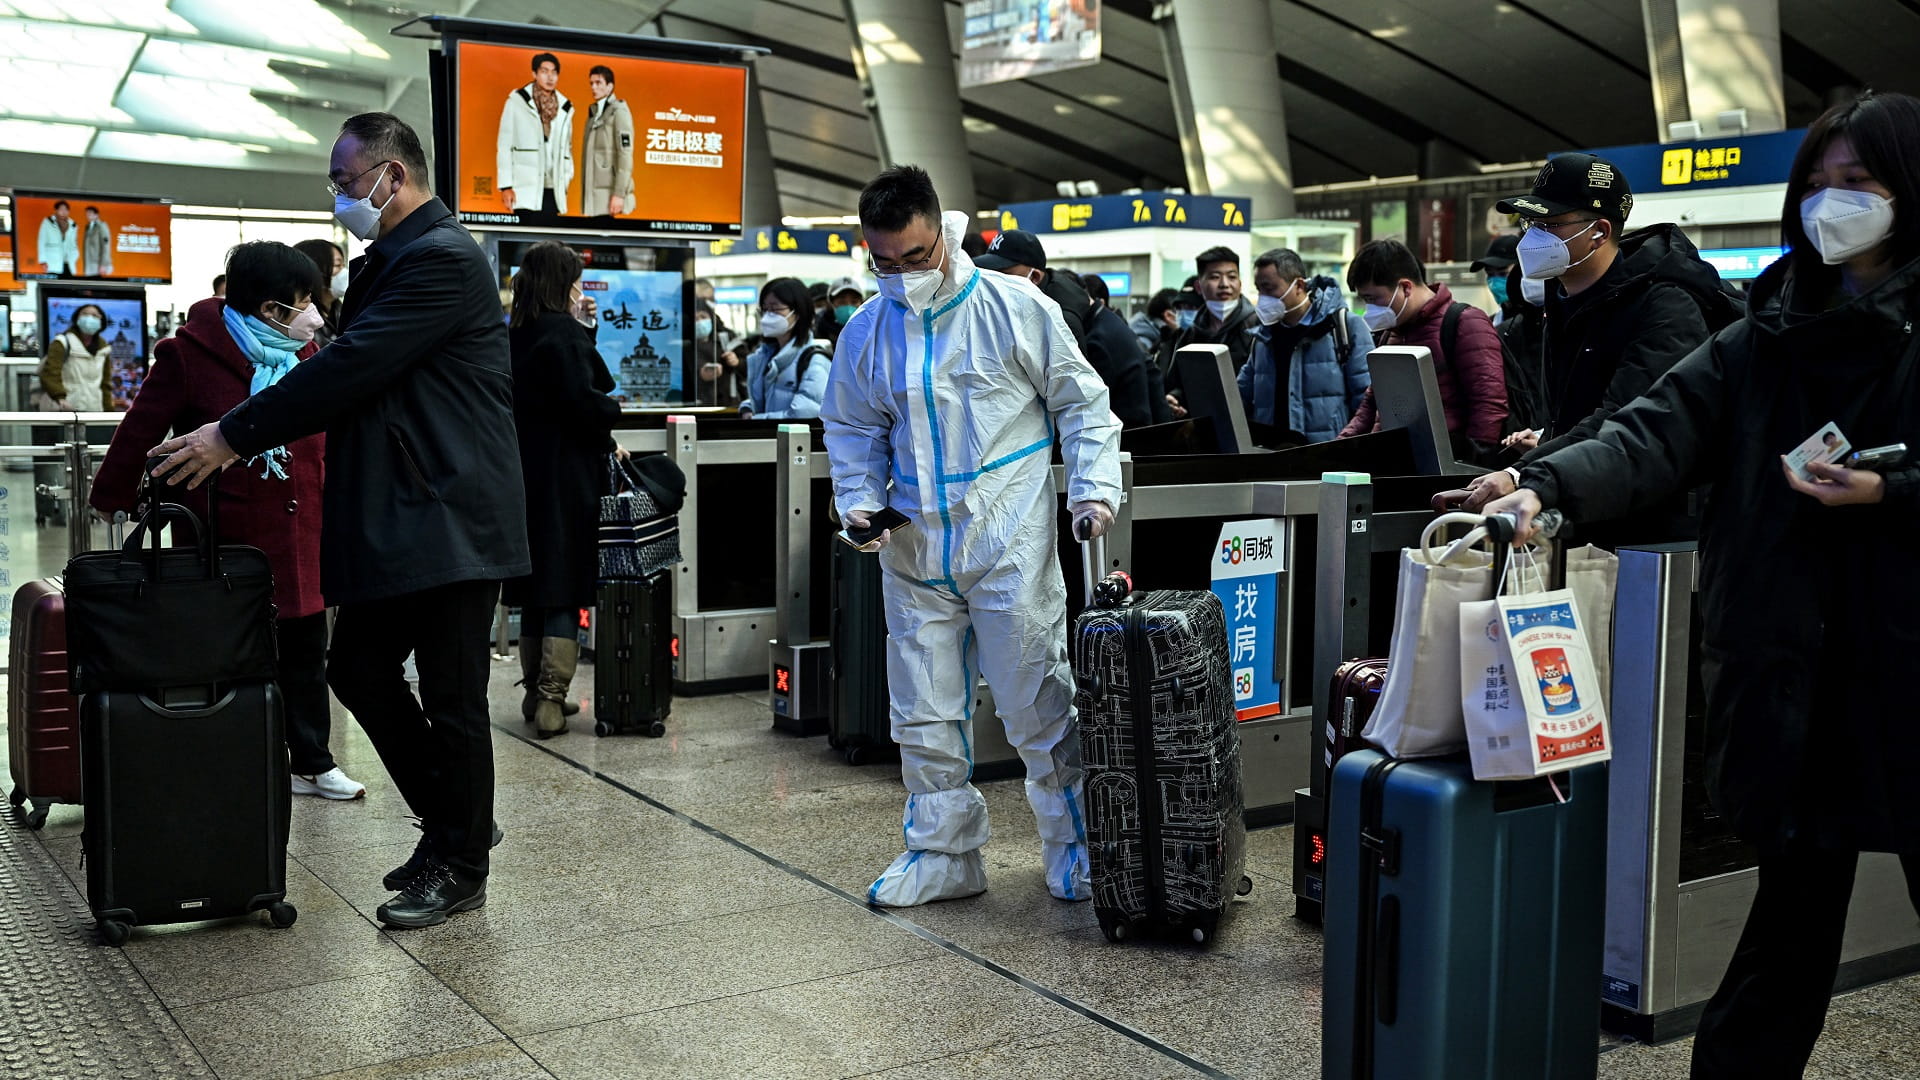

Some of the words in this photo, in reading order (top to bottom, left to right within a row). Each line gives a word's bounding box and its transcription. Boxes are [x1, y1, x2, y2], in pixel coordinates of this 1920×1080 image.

[646, 128, 722, 153] 无惧极寒
[1695, 147, 1741, 169] 检票口
[1132, 199, 1151, 222] 7A
[1164, 199, 1187, 223] 7A
[1222, 203, 1245, 226] 7A
[602, 301, 671, 331] 味道
[1221, 535, 1273, 565] 58同城
[1233, 583, 1259, 663] 找房
[1236, 672, 1251, 694] 58
